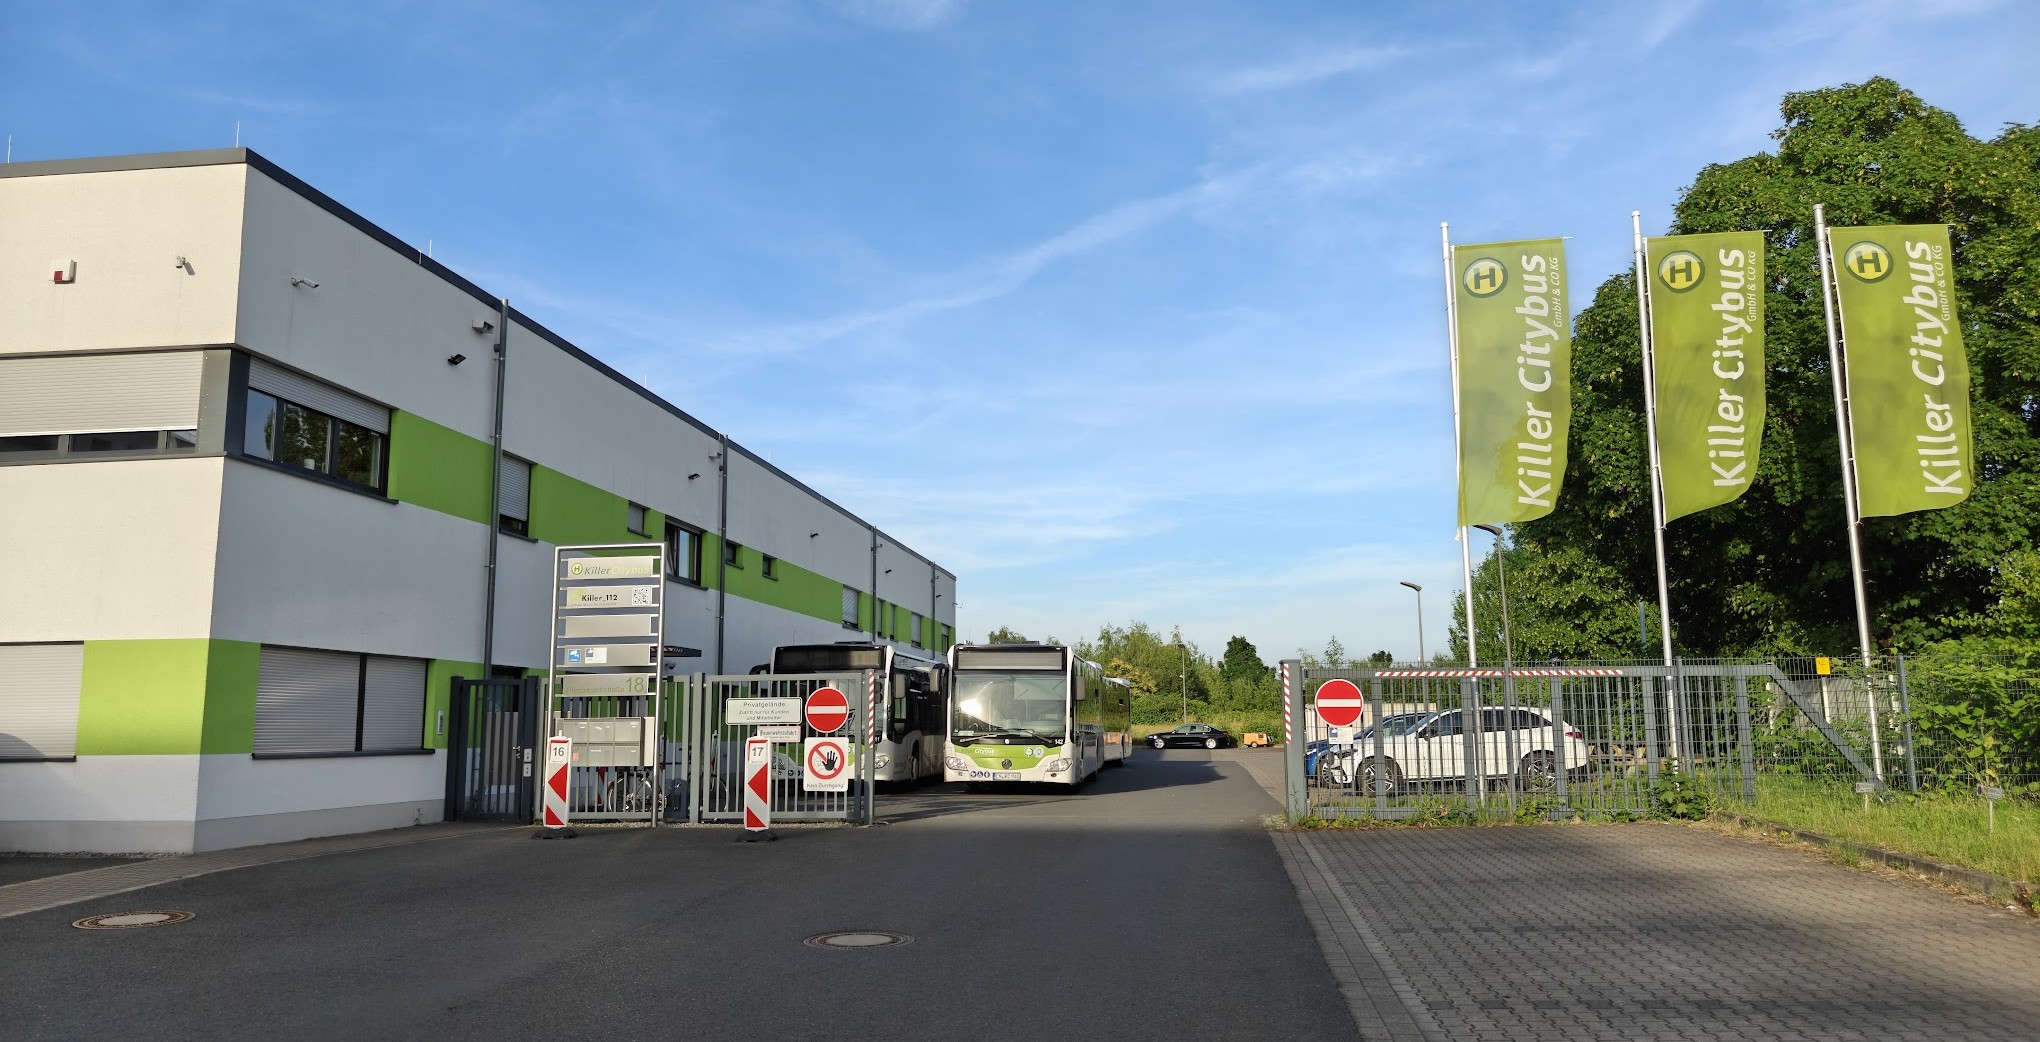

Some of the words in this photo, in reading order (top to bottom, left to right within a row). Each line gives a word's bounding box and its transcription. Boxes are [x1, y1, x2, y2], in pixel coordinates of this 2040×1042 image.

[1747, 250, 1756, 265] KG
[1931, 245, 1942, 260] KG
[1550, 256, 1559, 270] KG
[1854, 250, 1882, 274] H
[1936, 262, 1944, 277] CO
[1473, 266, 1497, 290] H
[1551, 272, 1560, 286] CO
[1669, 260, 1693, 284] H
[1747, 266, 1756, 281] CO
[1749, 283, 1756, 291] &
[1937, 279, 1946, 288] &
[1553, 288, 1561, 296] &
[1553, 298, 1563, 328] GmbH
[1746, 294, 1757, 322] GmbH
[1902, 240, 1949, 386] Citybus
[1936, 290, 1951, 322] GmbH
[1711, 248, 1753, 380] Citybus
[1515, 254, 1559, 393] Citybus
[1707, 388, 1746, 487] Killer
[1916, 393, 1964, 495] Killer
[1516, 401, 1553, 507] Killer
[584, 566, 611, 575] Killer
[611, 565, 650, 576] Citybus
[581, 594, 618, 602] Killer_112
[625, 676, 644, 693] 18
[743, 701, 786, 709] Privatgelände
[553, 746, 565, 757] 16
[751, 746, 764, 757] 17
